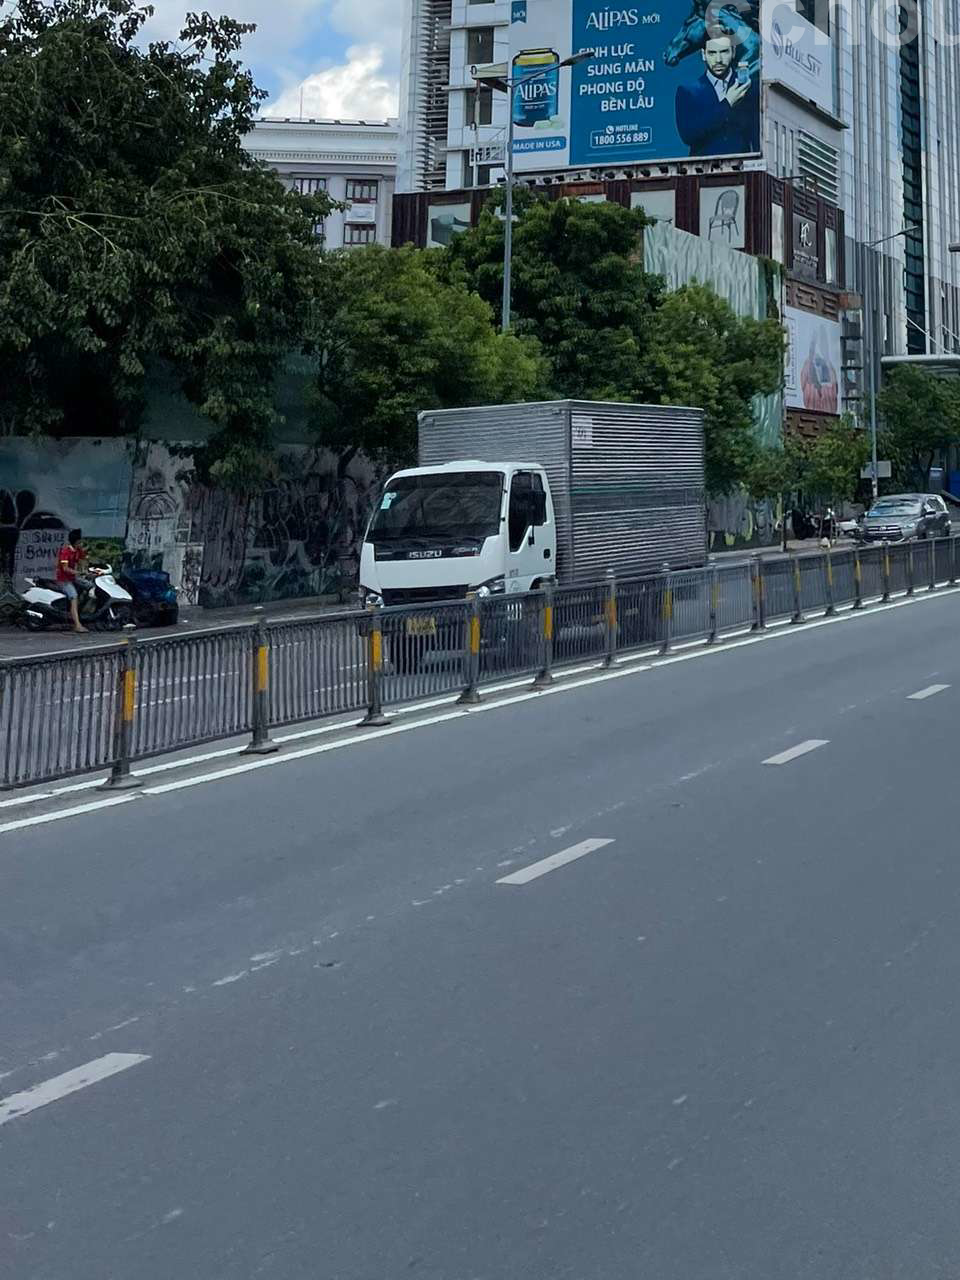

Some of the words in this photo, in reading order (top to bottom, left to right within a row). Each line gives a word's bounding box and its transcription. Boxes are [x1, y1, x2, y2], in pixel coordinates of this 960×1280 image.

[587, 62, 621, 77] SUNG
[624, 58, 655, 73] MÃN
[579, 81, 624, 96] PHONG
[626, 76, 645, 94] ĐỘ
[629, 94, 655, 109] LÂU
[512, 142, 535, 151] MADE
[536, 141, 544, 149] IN
[545, 139, 561, 148] USA
[593, 134, 615, 145] 1800
[616, 133, 632, 144] 556
[632, 132, 649, 142] 889
[409, 549, 443, 559] ISUZU
